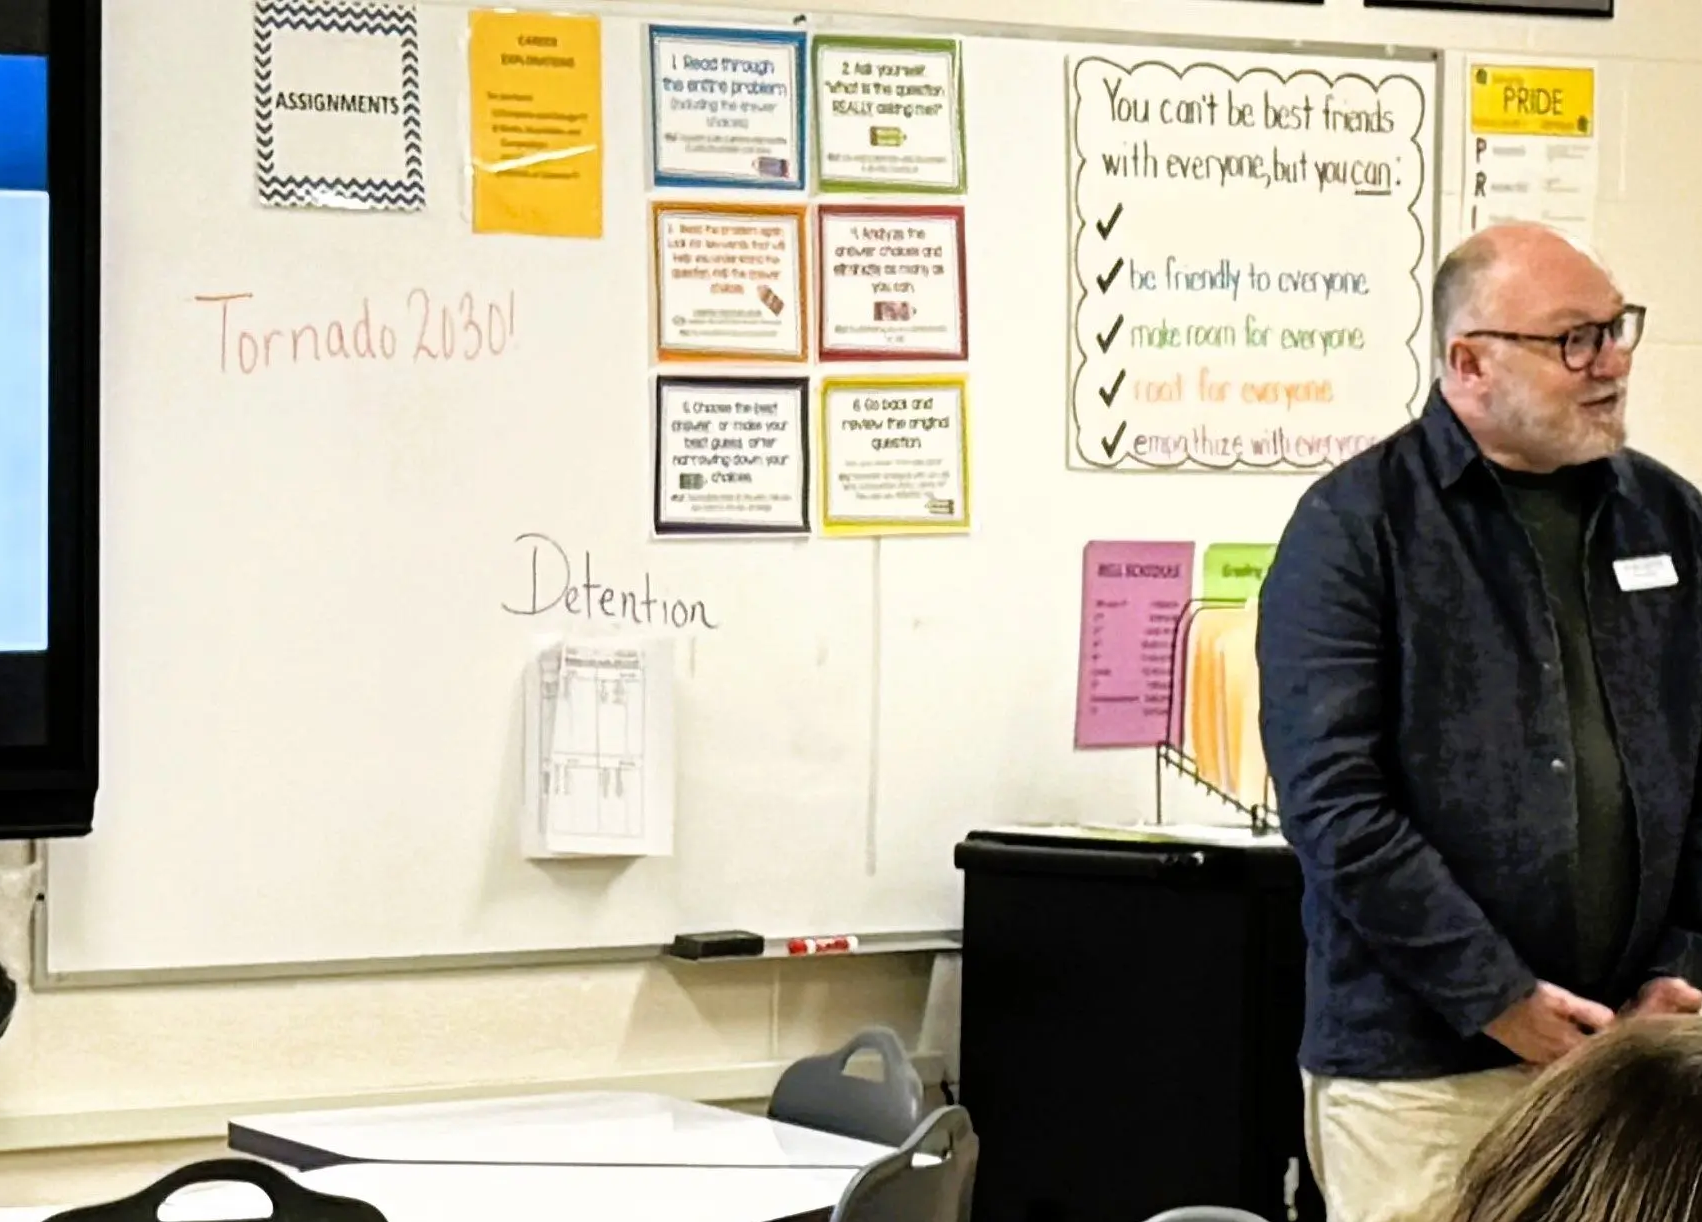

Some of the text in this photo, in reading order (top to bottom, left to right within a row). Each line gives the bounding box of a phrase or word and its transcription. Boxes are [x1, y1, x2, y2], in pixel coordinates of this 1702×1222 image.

[275, 90, 400, 116] ASSIGNMENTS
[1102, 76, 1395, 133] You can't be best friends
[1503, 86, 1565, 116] PRIDE
[1101, 139, 1158, 179] with
[1273, 144, 1308, 183] but
[1314, 158, 1347, 193] you
[1476, 137, 1487, 164] P
[1474, 171, 1487, 197] R
[1129, 258, 1157, 292] be
[1166, 255, 1241, 302] friendly
[1249, 262, 1272, 292] to
[195, 287, 515, 374] Tornado 2030!
[1130, 318, 1181, 349] make
[1186, 324, 1236, 349] room
[1244, 312, 1273, 348] for
[1134, 366, 1335, 411] root for everyone
[501, 532, 722, 630] Detention
